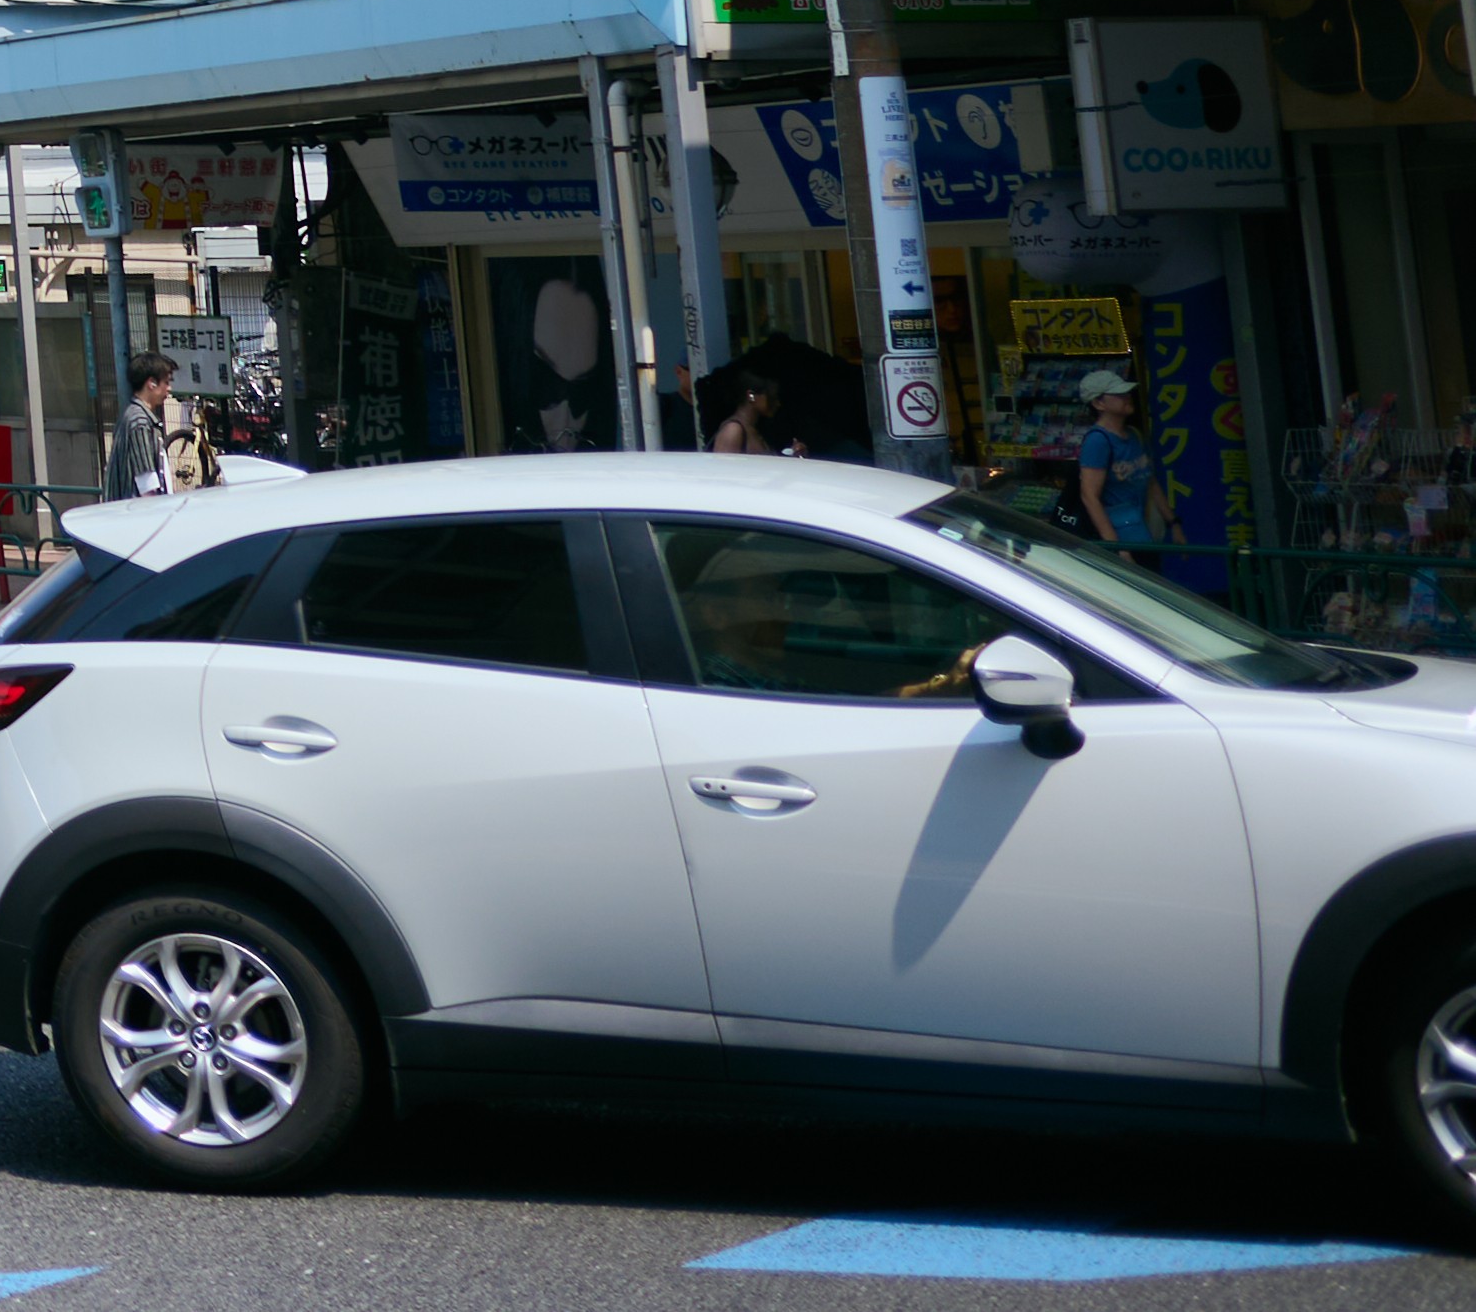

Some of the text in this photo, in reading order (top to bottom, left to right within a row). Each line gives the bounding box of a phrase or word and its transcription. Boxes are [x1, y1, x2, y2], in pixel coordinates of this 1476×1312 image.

[468, 133, 595, 160] メガネスーパー
[446, 187, 511, 206] コンタクト
[1152, 302, 1193, 510] コンタクト
